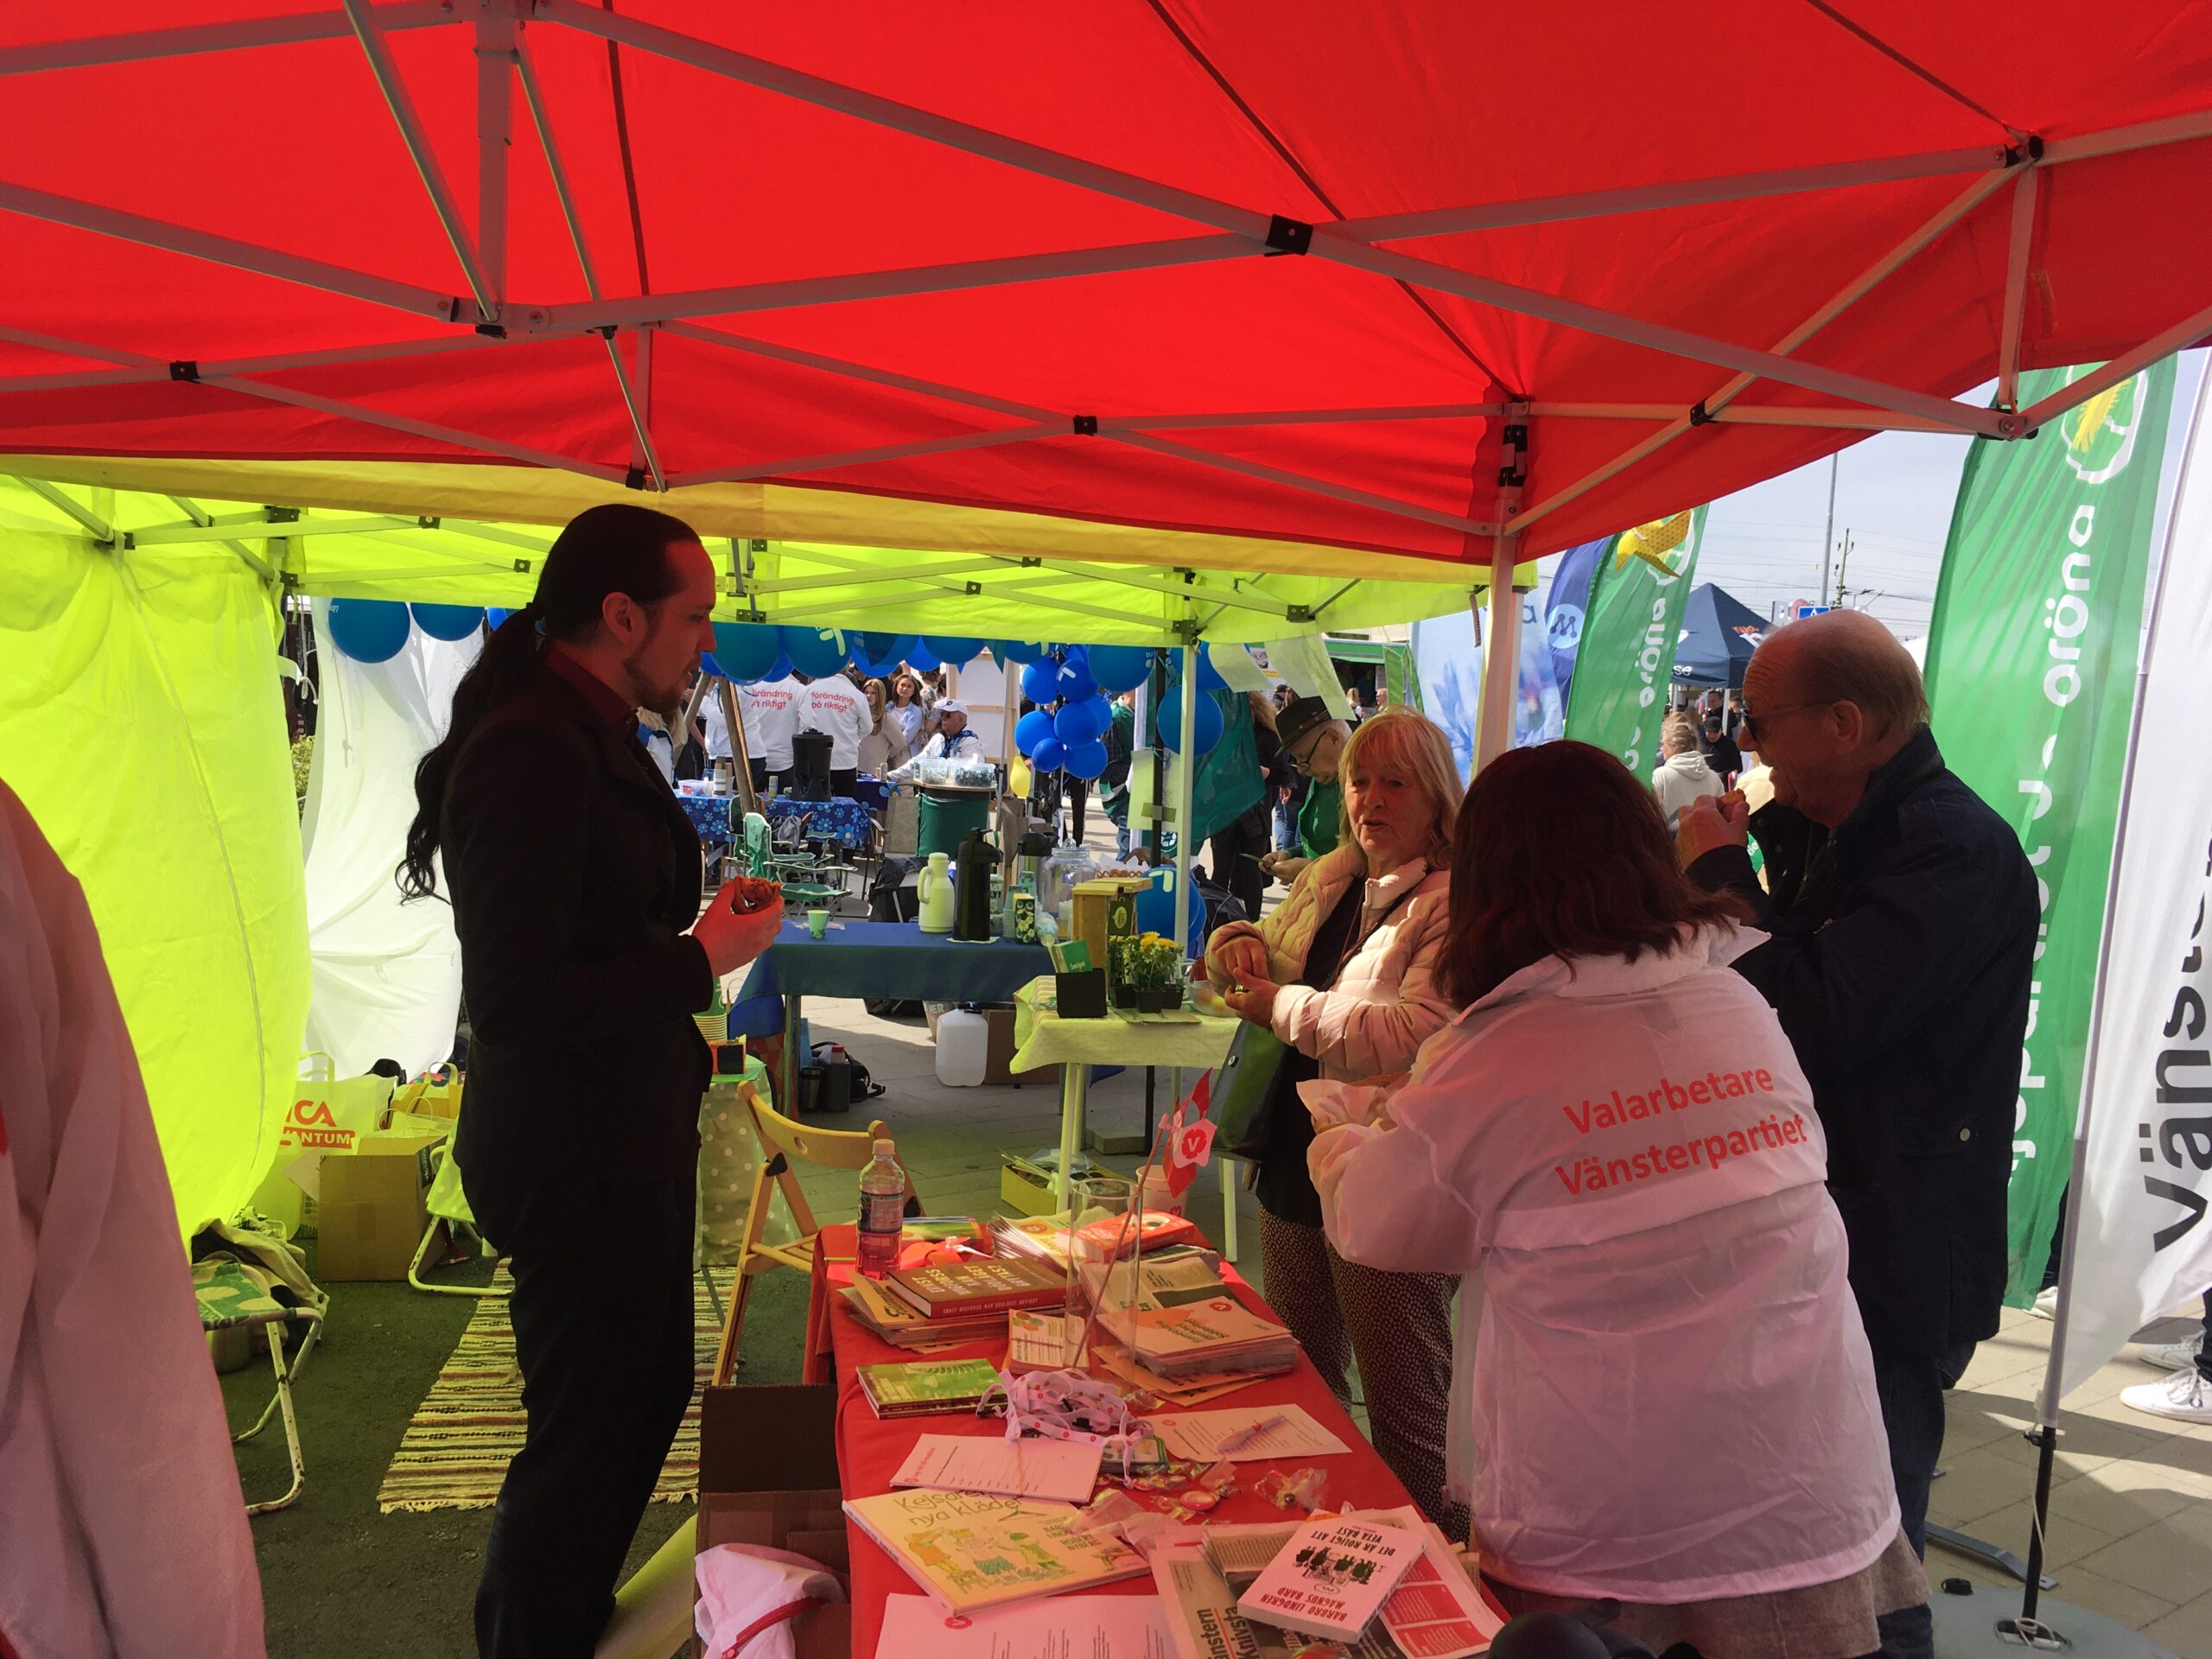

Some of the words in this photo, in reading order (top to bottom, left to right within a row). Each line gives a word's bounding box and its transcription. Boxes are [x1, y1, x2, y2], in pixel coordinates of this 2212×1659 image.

[762, 700, 786, 710] riktigt
[811, 690, 855, 706] förändring
[823, 702, 848, 714] riktigt
[2139, 836, 2212, 1253] Väns
[1562, 1068, 1775, 1135] Valarbetare
[1555, 1114, 1808, 1195] Vänsterpartiet
[908, 1511, 950, 1529] nya
[953, 1495, 1023, 1517] kläder
[1310, 1530, 1329, 1541] ATT
[1336, 1526, 1362, 1539] BÄST
[1362, 1532, 1383, 1543] VETA
[1329, 1535, 1363, 1550] ROLIGT
[1363, 1541, 1376, 1554] ÄR
[1376, 1546, 1396, 1556] DET
[1277, 1586, 1305, 1599] BARD
[1259, 1593, 1306, 1612] LINDGREN
[1305, 1593, 1346, 1609] MAGNUS
[1307, 1605, 1348, 1622] BARBRO
[1223, 1605, 1262, 1659] Knivsta
